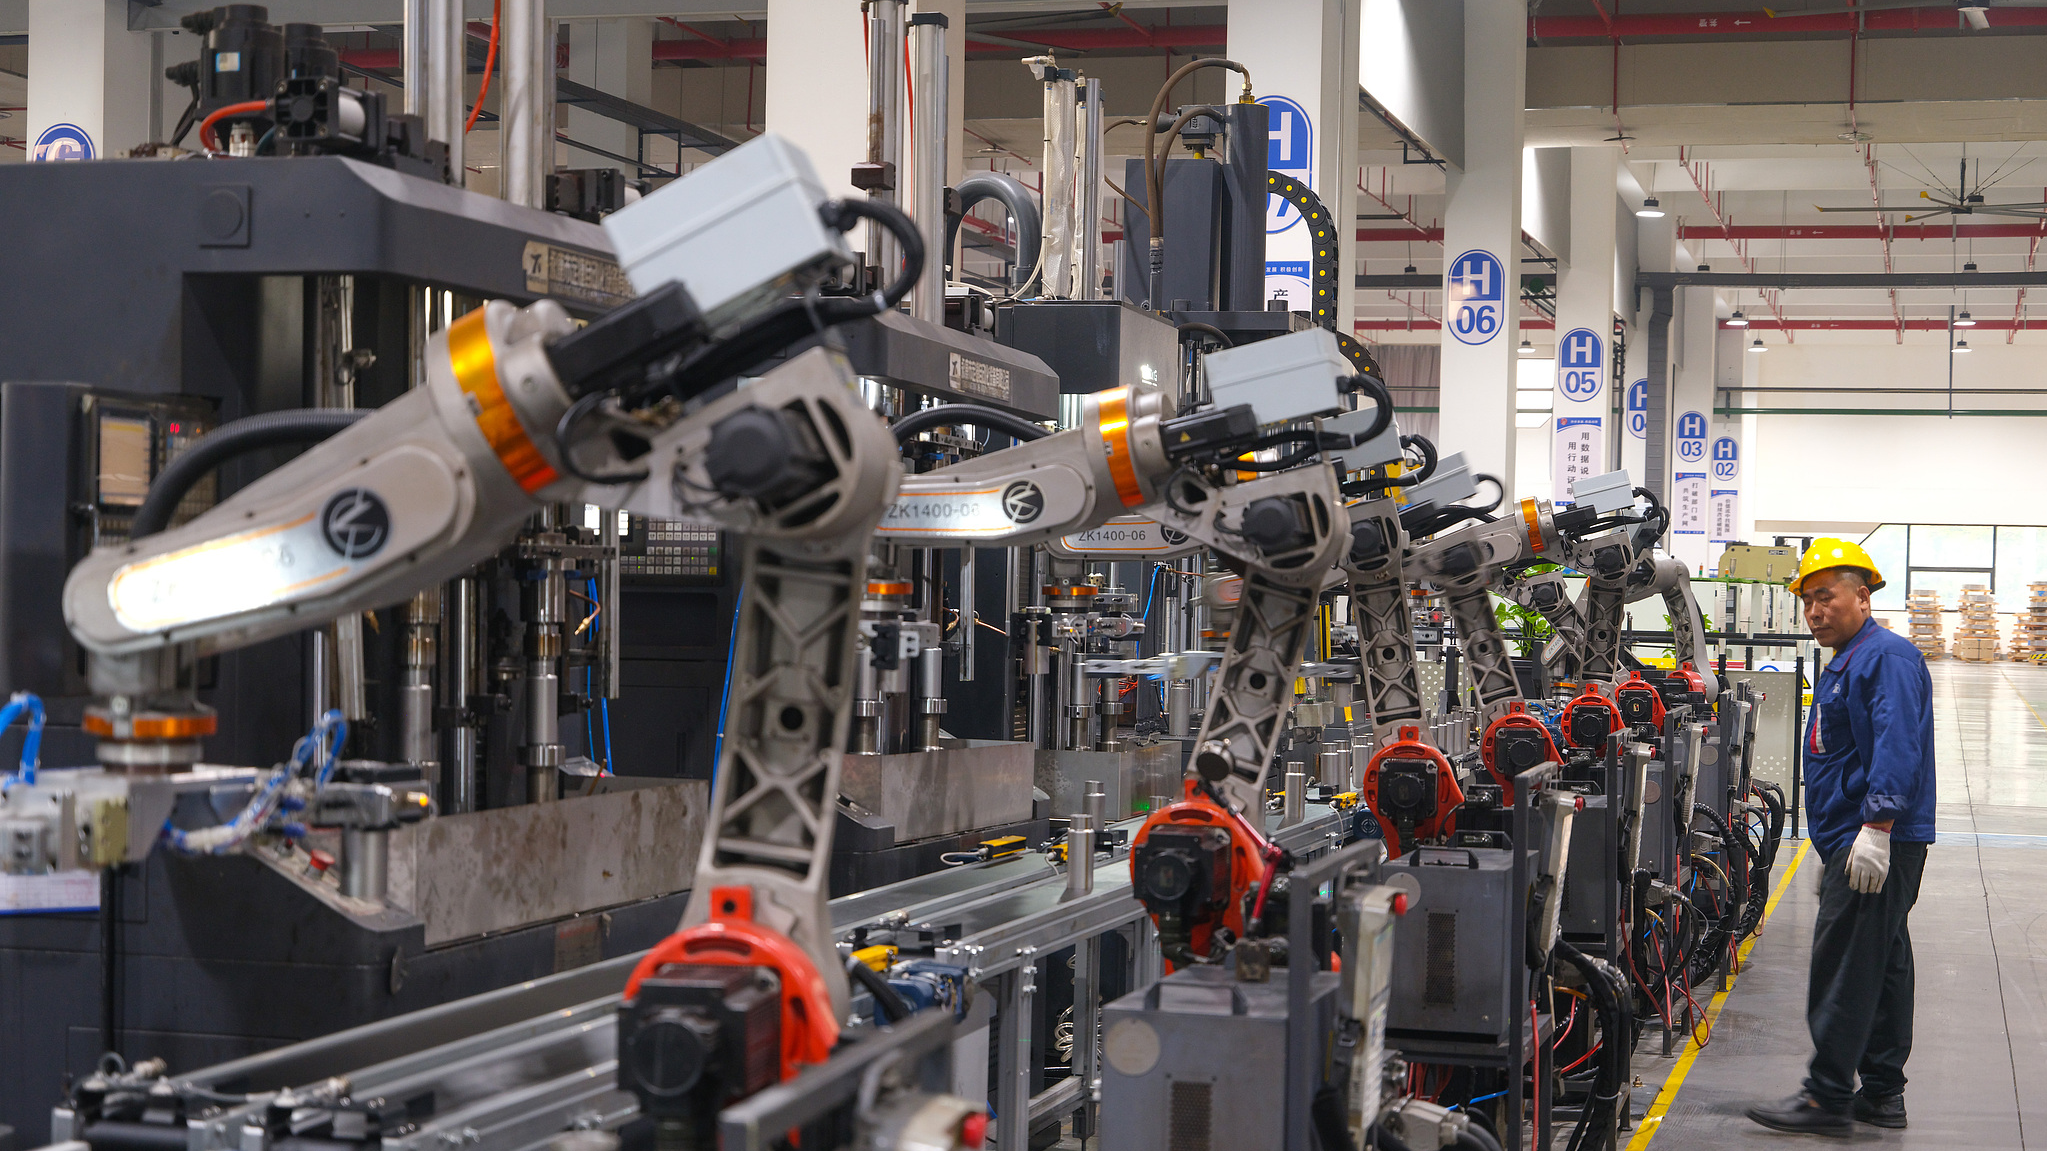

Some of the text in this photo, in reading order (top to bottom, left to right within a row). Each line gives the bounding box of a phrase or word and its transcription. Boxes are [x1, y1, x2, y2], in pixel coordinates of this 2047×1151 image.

[1462, 260, 1490, 295] H
[1456, 305, 1496, 334] 06
[1570, 336, 1593, 363] H
[1565, 371, 1596, 394] 05
[1632, 413, 1647, 432] 0
[1684, 417, 1701, 436] H
[1580, 432, 1590, 480] 用数据说
[1681, 441, 1702, 456] 03
[1718, 441, 1733, 458] H
[1715, 462, 1734, 476] 02
[1078, 530, 1146, 541] ZK1400-06
